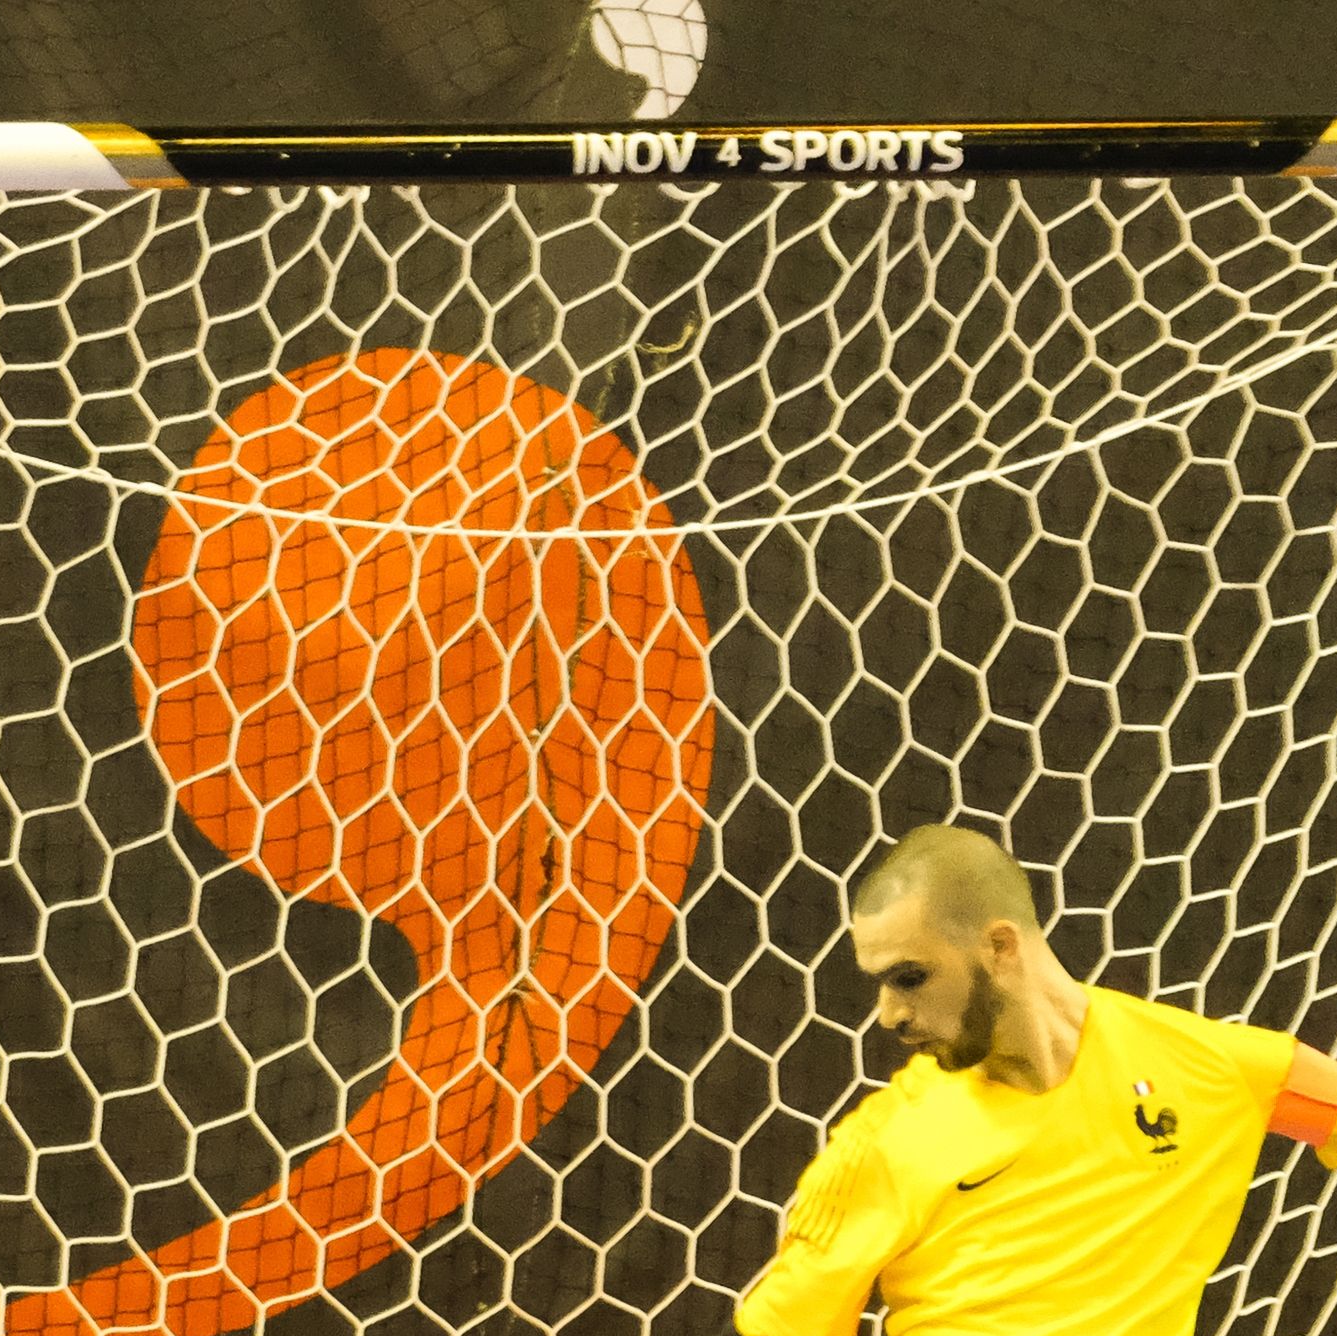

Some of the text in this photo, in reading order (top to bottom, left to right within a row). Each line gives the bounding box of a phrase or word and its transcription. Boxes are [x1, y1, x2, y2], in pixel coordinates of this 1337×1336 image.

[571, 131, 964, 175] INOV 4 SPORTS
